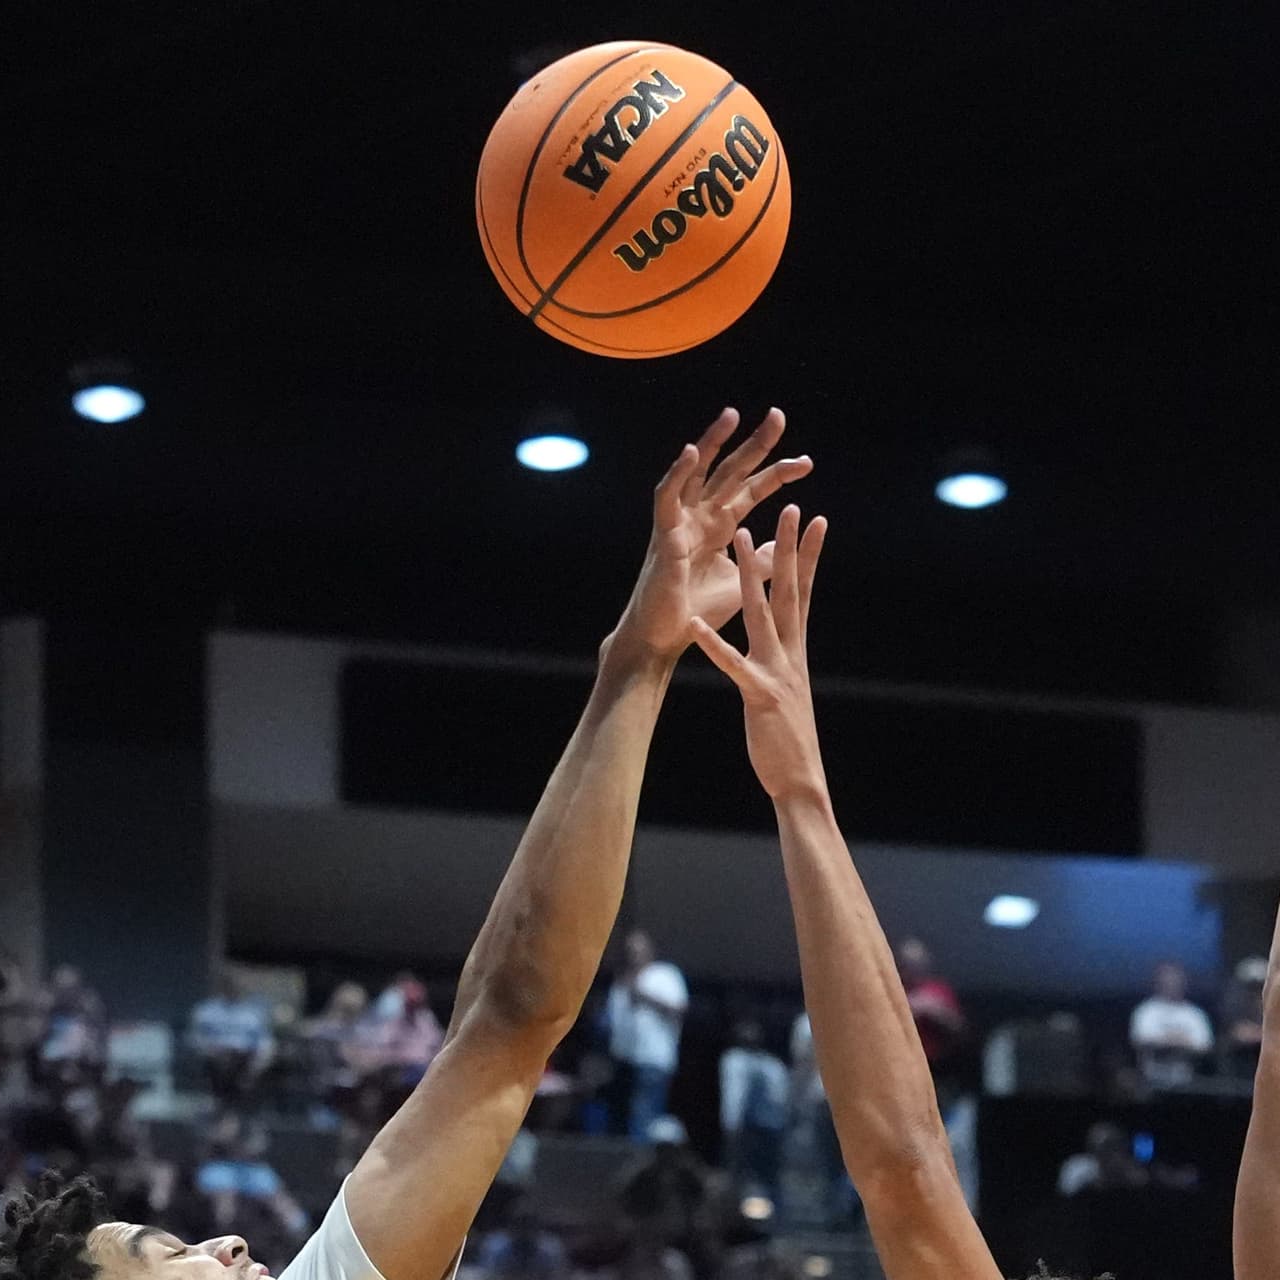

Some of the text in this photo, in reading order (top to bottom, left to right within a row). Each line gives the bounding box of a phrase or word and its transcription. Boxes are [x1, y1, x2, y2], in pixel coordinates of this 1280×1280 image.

[562, 70, 686, 193] NCAA
[663, 148, 707, 198] EVO NXT
[611, 114, 770, 273] Wilson
